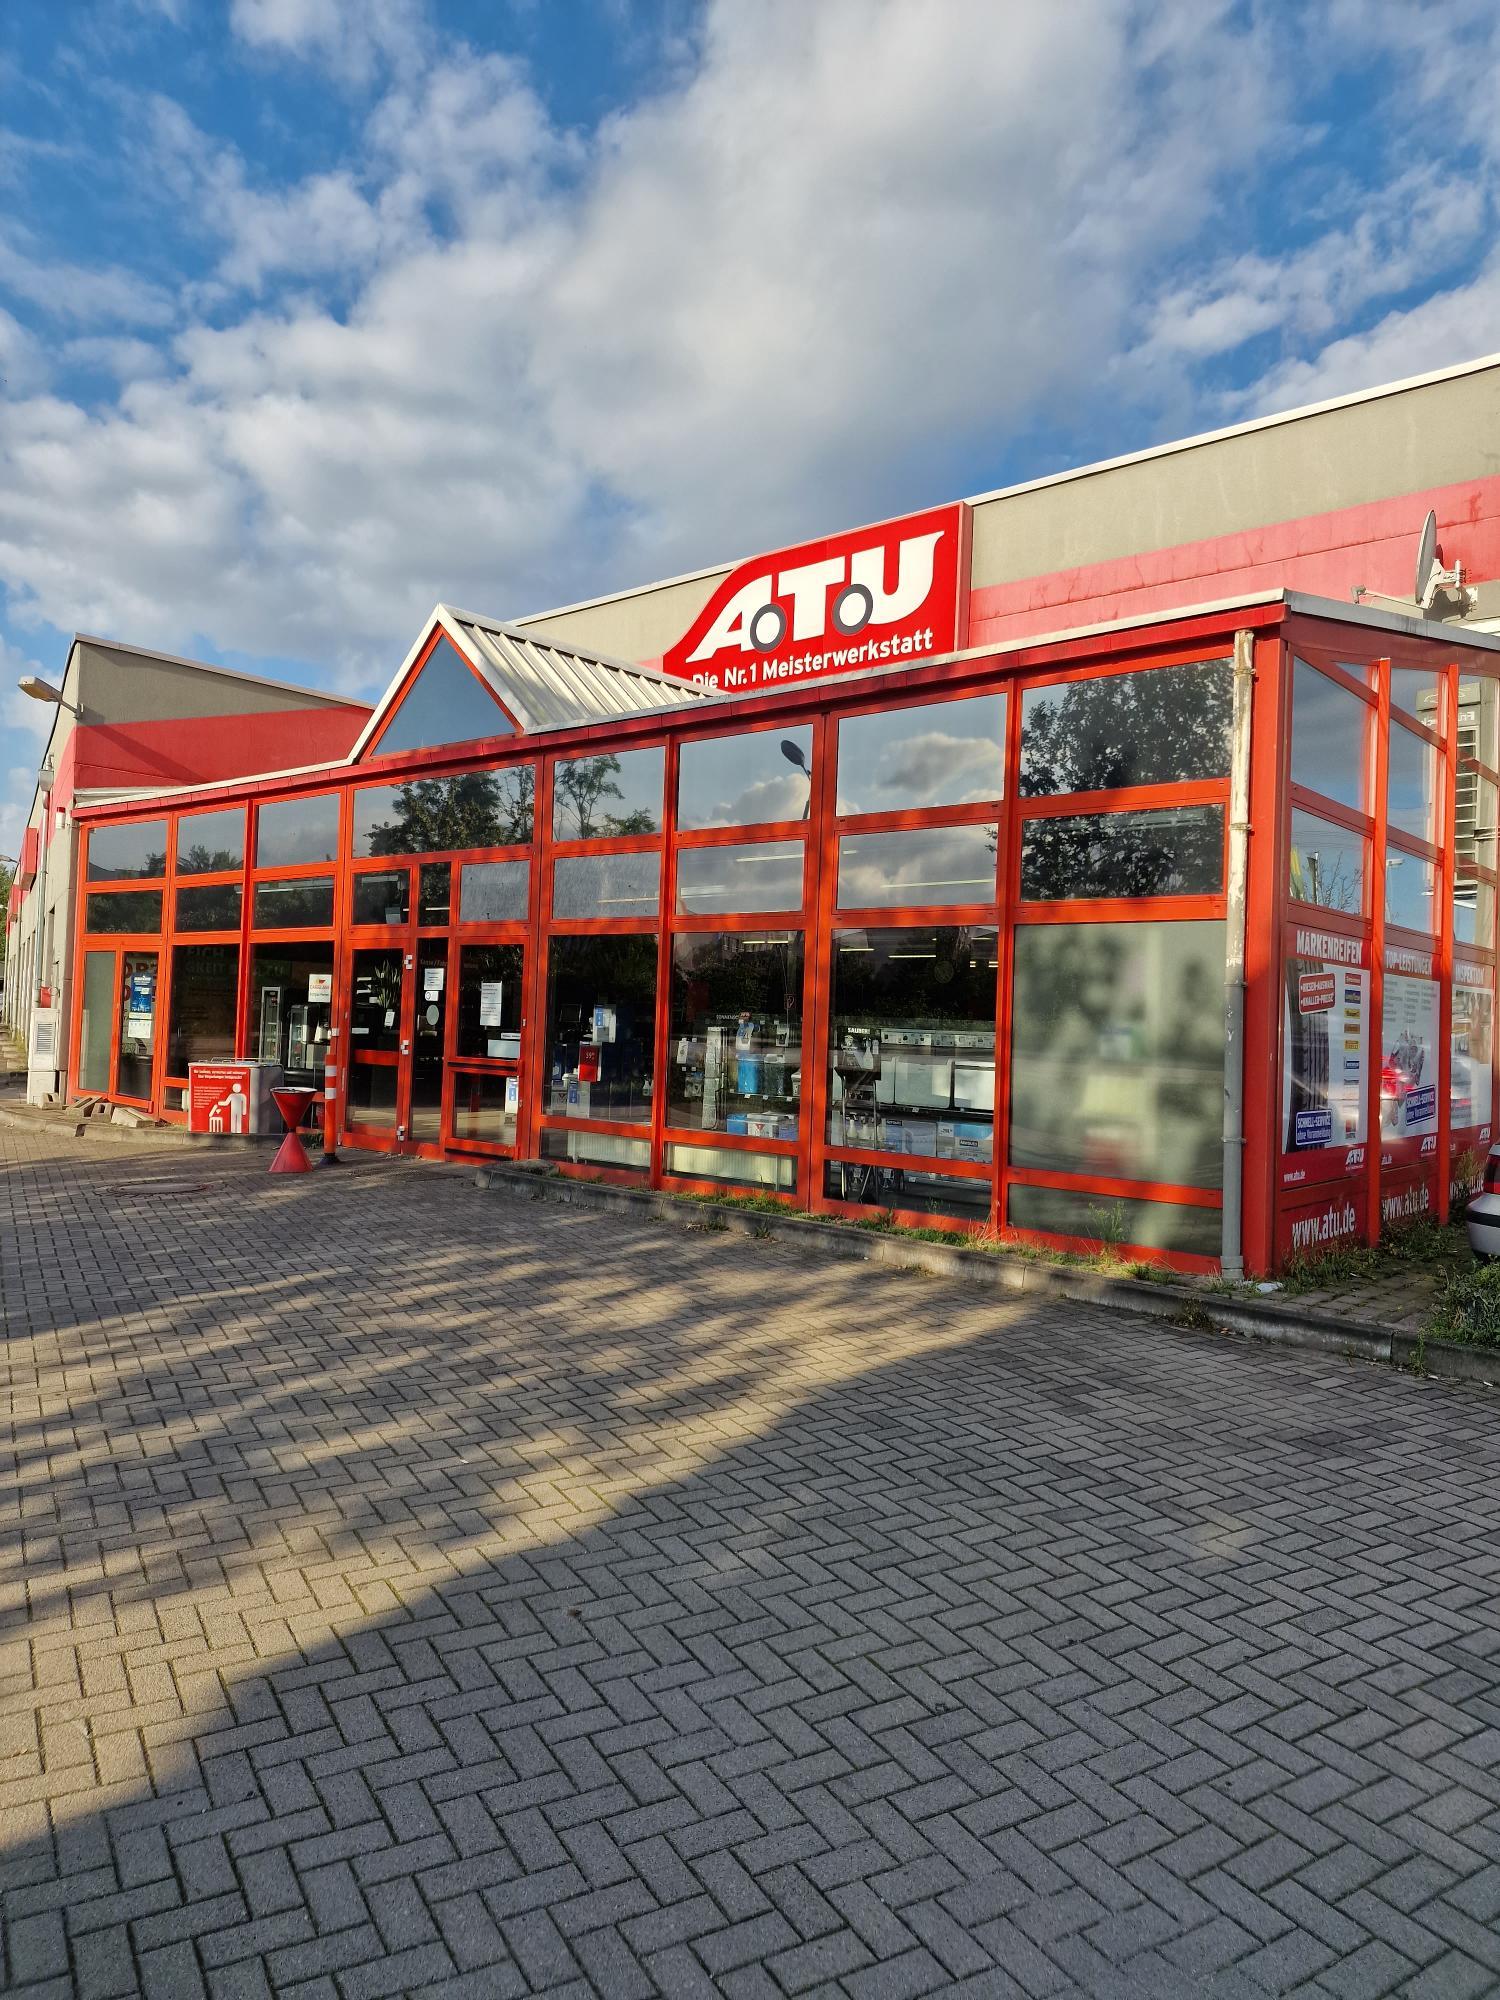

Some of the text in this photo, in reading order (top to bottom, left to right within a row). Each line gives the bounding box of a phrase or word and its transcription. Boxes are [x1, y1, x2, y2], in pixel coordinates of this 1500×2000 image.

[685, 530, 945, 663] ATU
[762, 627, 934, 681] Meisterwerkstatt
[1296, 930, 1363, 965] MARKENREIFEN
[1297, 1115, 1331, 1129] SCHNELL-SERVICE
[1480, 1127, 1491, 1141] ATU
[1346, 1148, 1365, 1165] ATU
[1421, 1136, 1437, 1152] ATU
[1283, 1168, 1306, 1183] www.atu.de
[1382, 1182, 1430, 1222] www.atu.de
[1292, 1202, 1357, 1249] www.atu.de
